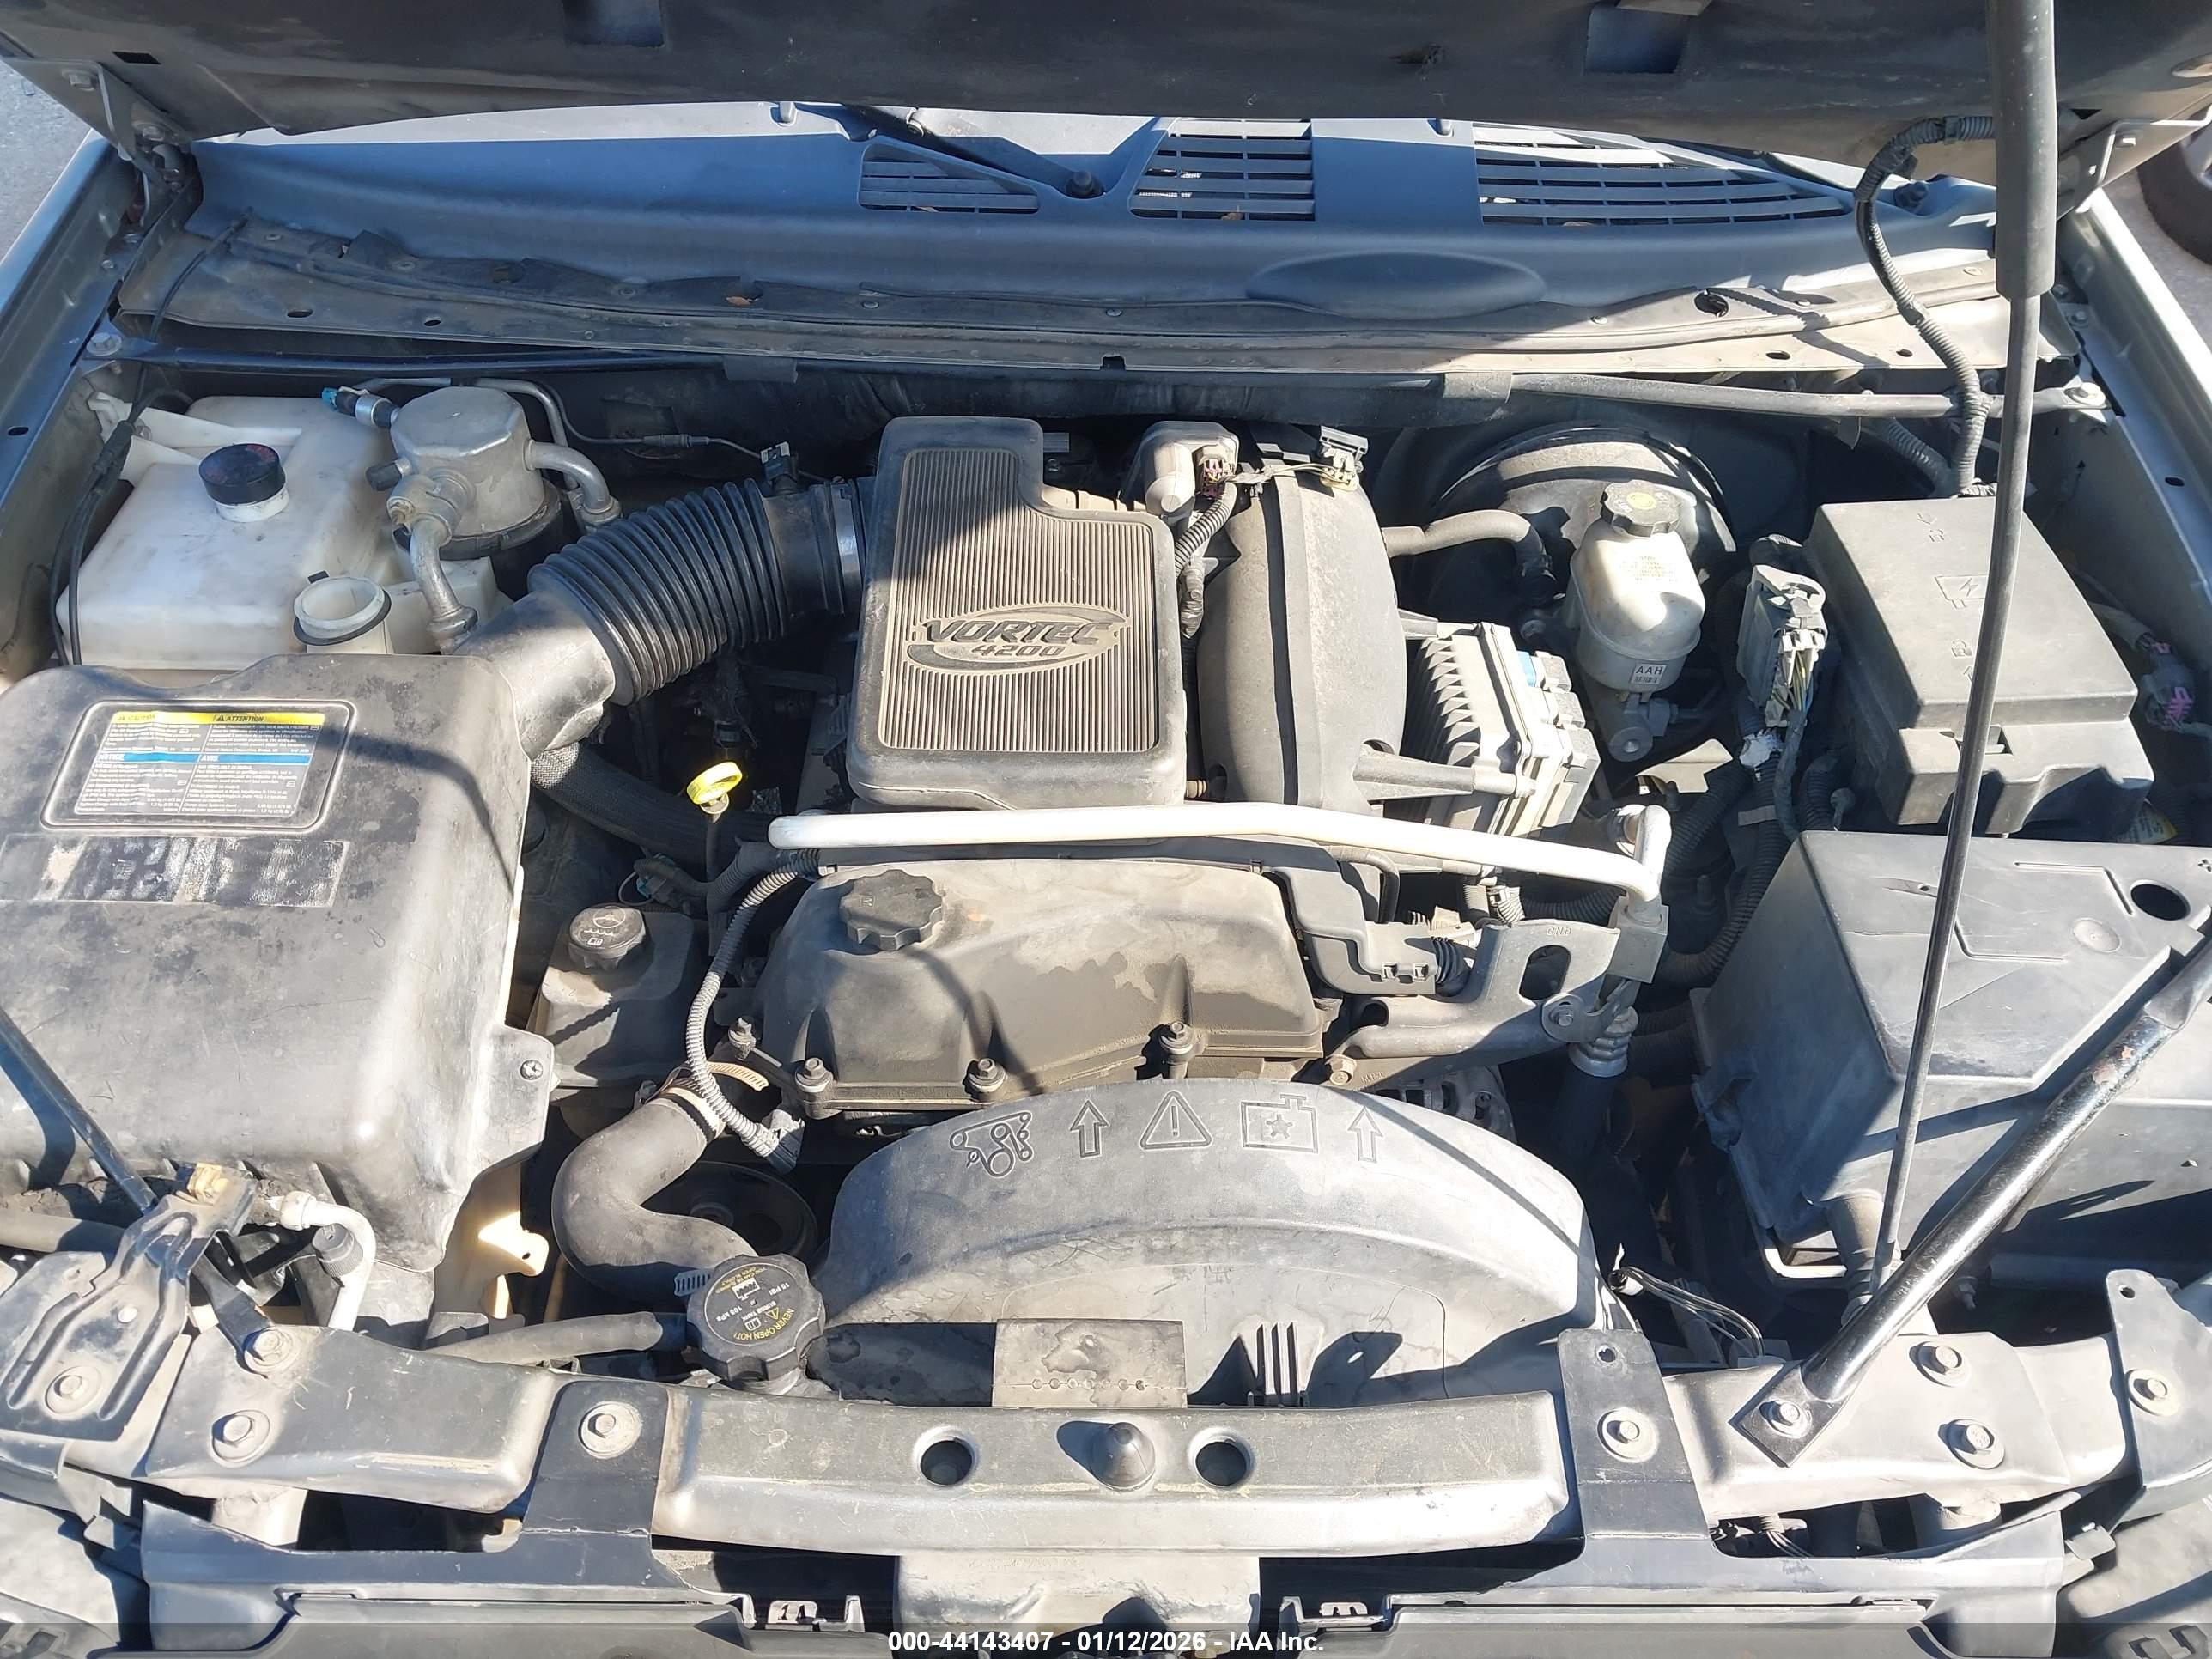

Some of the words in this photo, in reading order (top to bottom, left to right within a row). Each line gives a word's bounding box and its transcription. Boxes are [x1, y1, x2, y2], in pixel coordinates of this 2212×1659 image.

[922, 619, 1112, 645] VORTEC
[971, 644, 1066, 657] 4200
[1635, 665, 1663, 675] AAH
[225, 714, 264, 723] ATTENTION
[769, 1285, 781, 1296] PSI
[716, 1312, 730, 1322] kPa
[775, 1308, 795, 1330] NEVER
[732, 1332, 752, 1340] HOT!
[753, 1327, 775, 1340] OPEN
